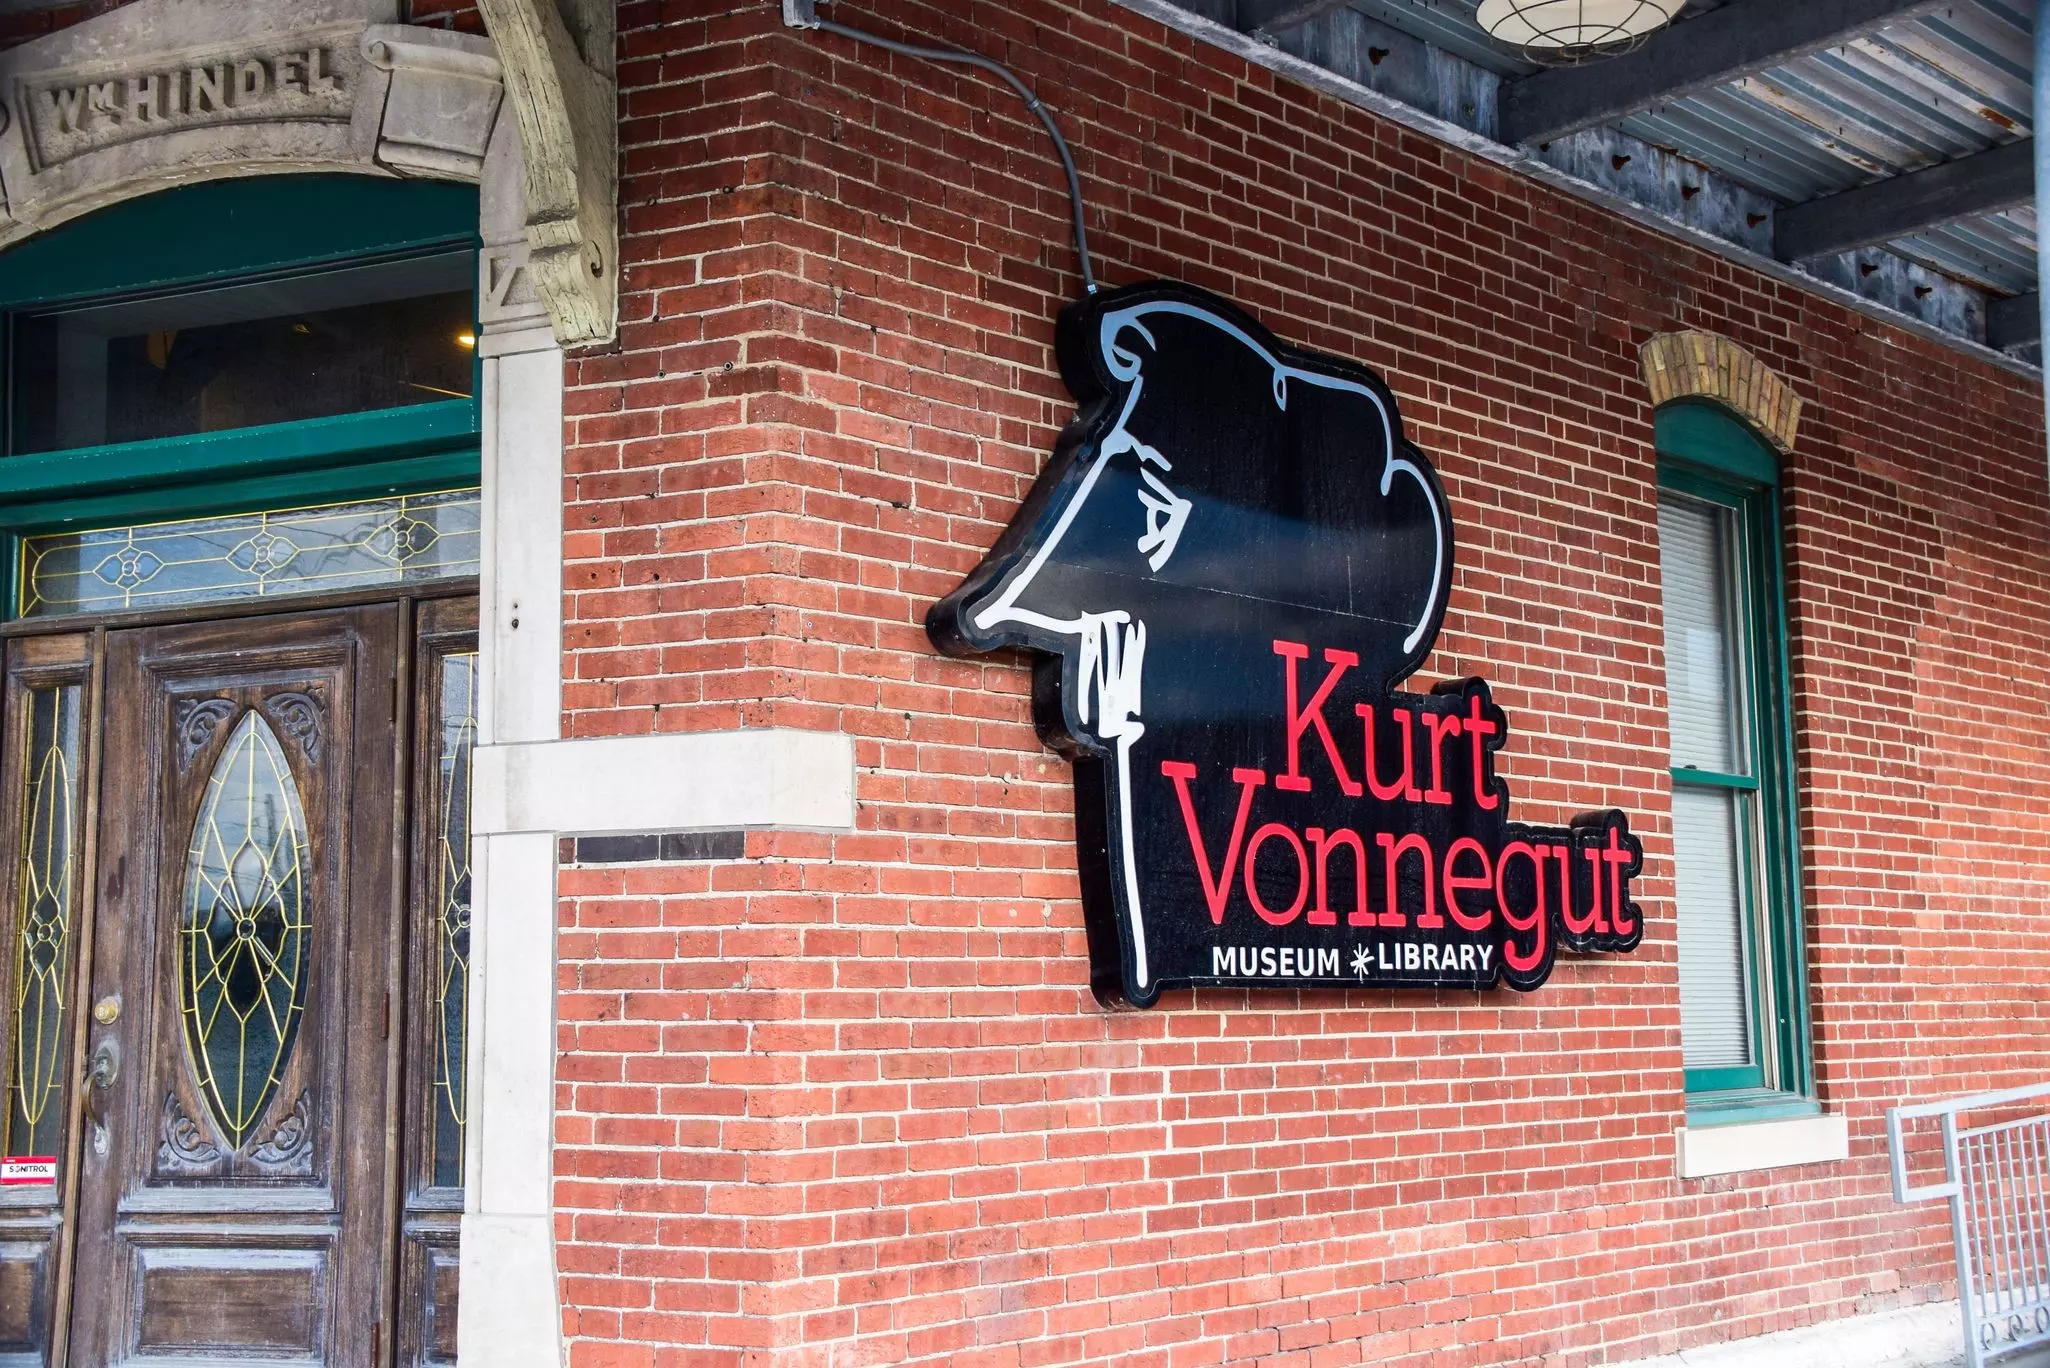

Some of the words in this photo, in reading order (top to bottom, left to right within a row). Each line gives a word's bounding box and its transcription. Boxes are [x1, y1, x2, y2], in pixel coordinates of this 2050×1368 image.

[127, 48, 346, 124] HINDEL
[1273, 640, 1498, 810] Kurt
[1161, 760, 1634, 972] Vonnegut
[1212, 946, 1340, 977] MUSEUM
[1378, 942, 1494, 972] LIBRARY
